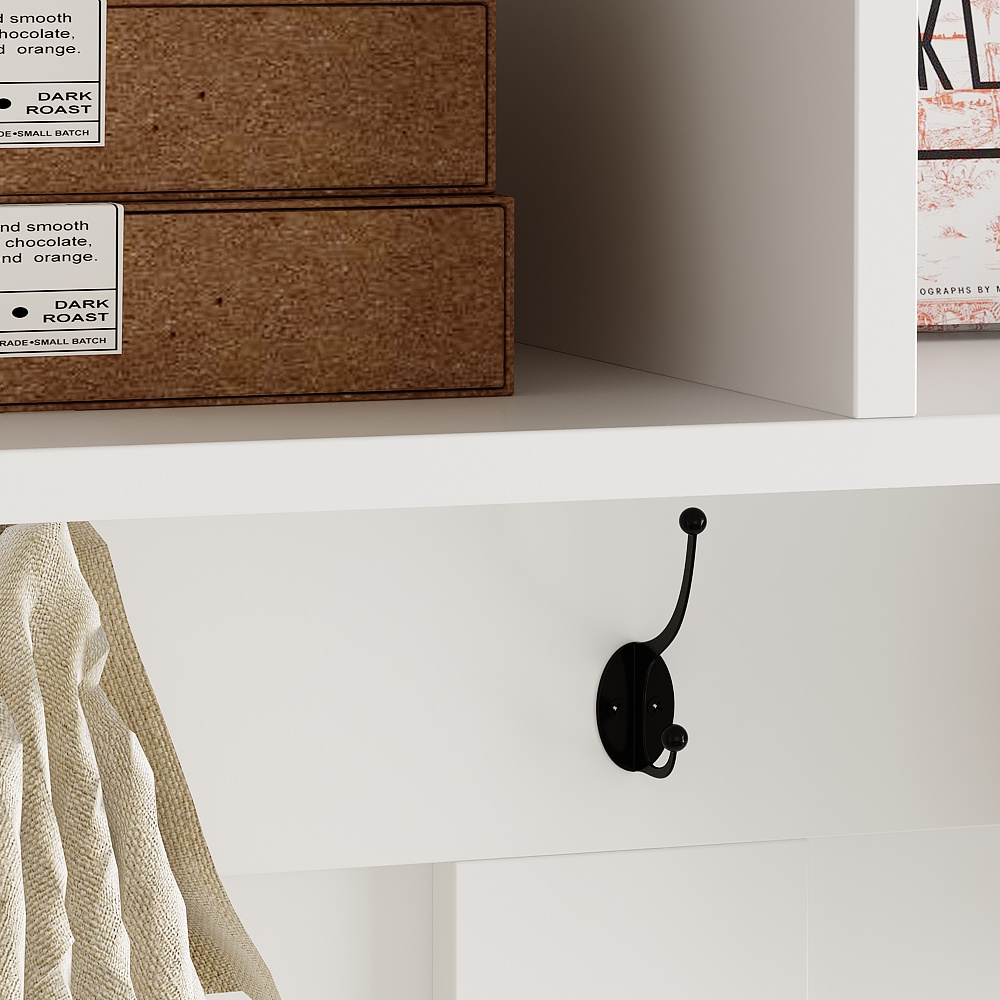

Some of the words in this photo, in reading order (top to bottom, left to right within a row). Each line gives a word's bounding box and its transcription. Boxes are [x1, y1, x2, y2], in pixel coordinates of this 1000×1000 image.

[10, 12, 71, 24] smooth
[17, 45, 80, 56] orange.
[39, 91, 92, 102] DARK
[27, 104, 91, 115] ROAST
[55, 129, 89, 137] BATCH
[27, 220, 88, 232] smooth
[6, 236, 91, 248] chocolate,
[34, 253, 97, 264] orange.
[919, 286, 972, 296] OGRAPHS
[977, 285, 990, 294] BY
[55, 298, 109, 310] DARK
[43, 312, 109, 324] ROAST
[72, 337, 106, 345] BATCH
